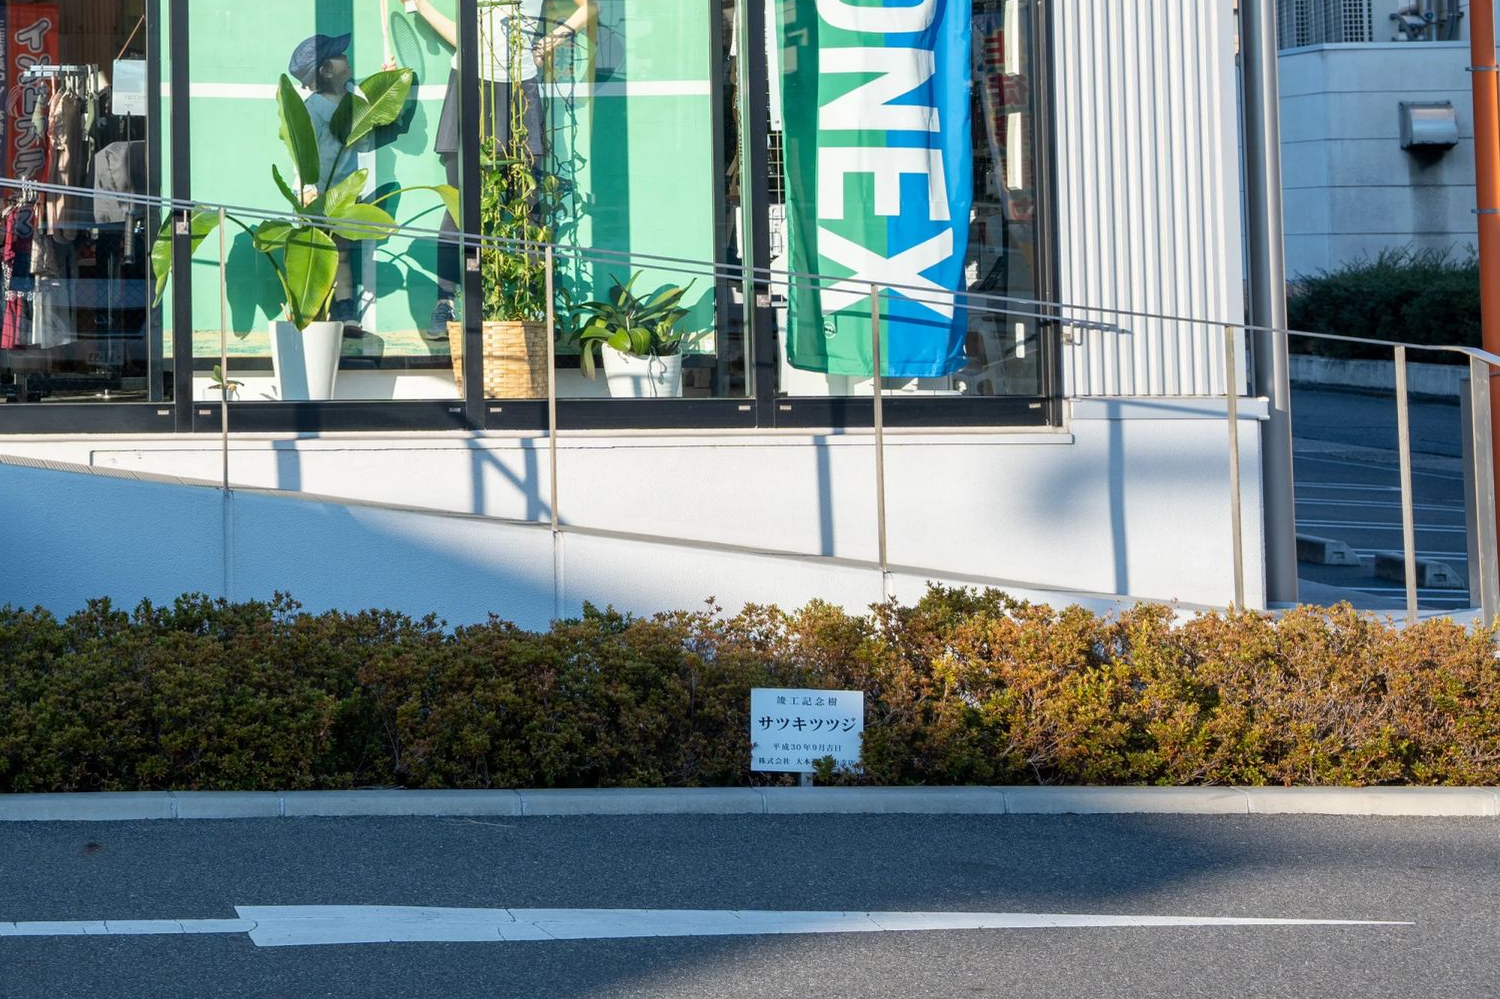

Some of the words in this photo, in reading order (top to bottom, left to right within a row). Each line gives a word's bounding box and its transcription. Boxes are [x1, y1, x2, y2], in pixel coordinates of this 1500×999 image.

[758, 715, 857, 732] サツキツツジ
[773, 742, 842, 752] 平成30年9月吉日
